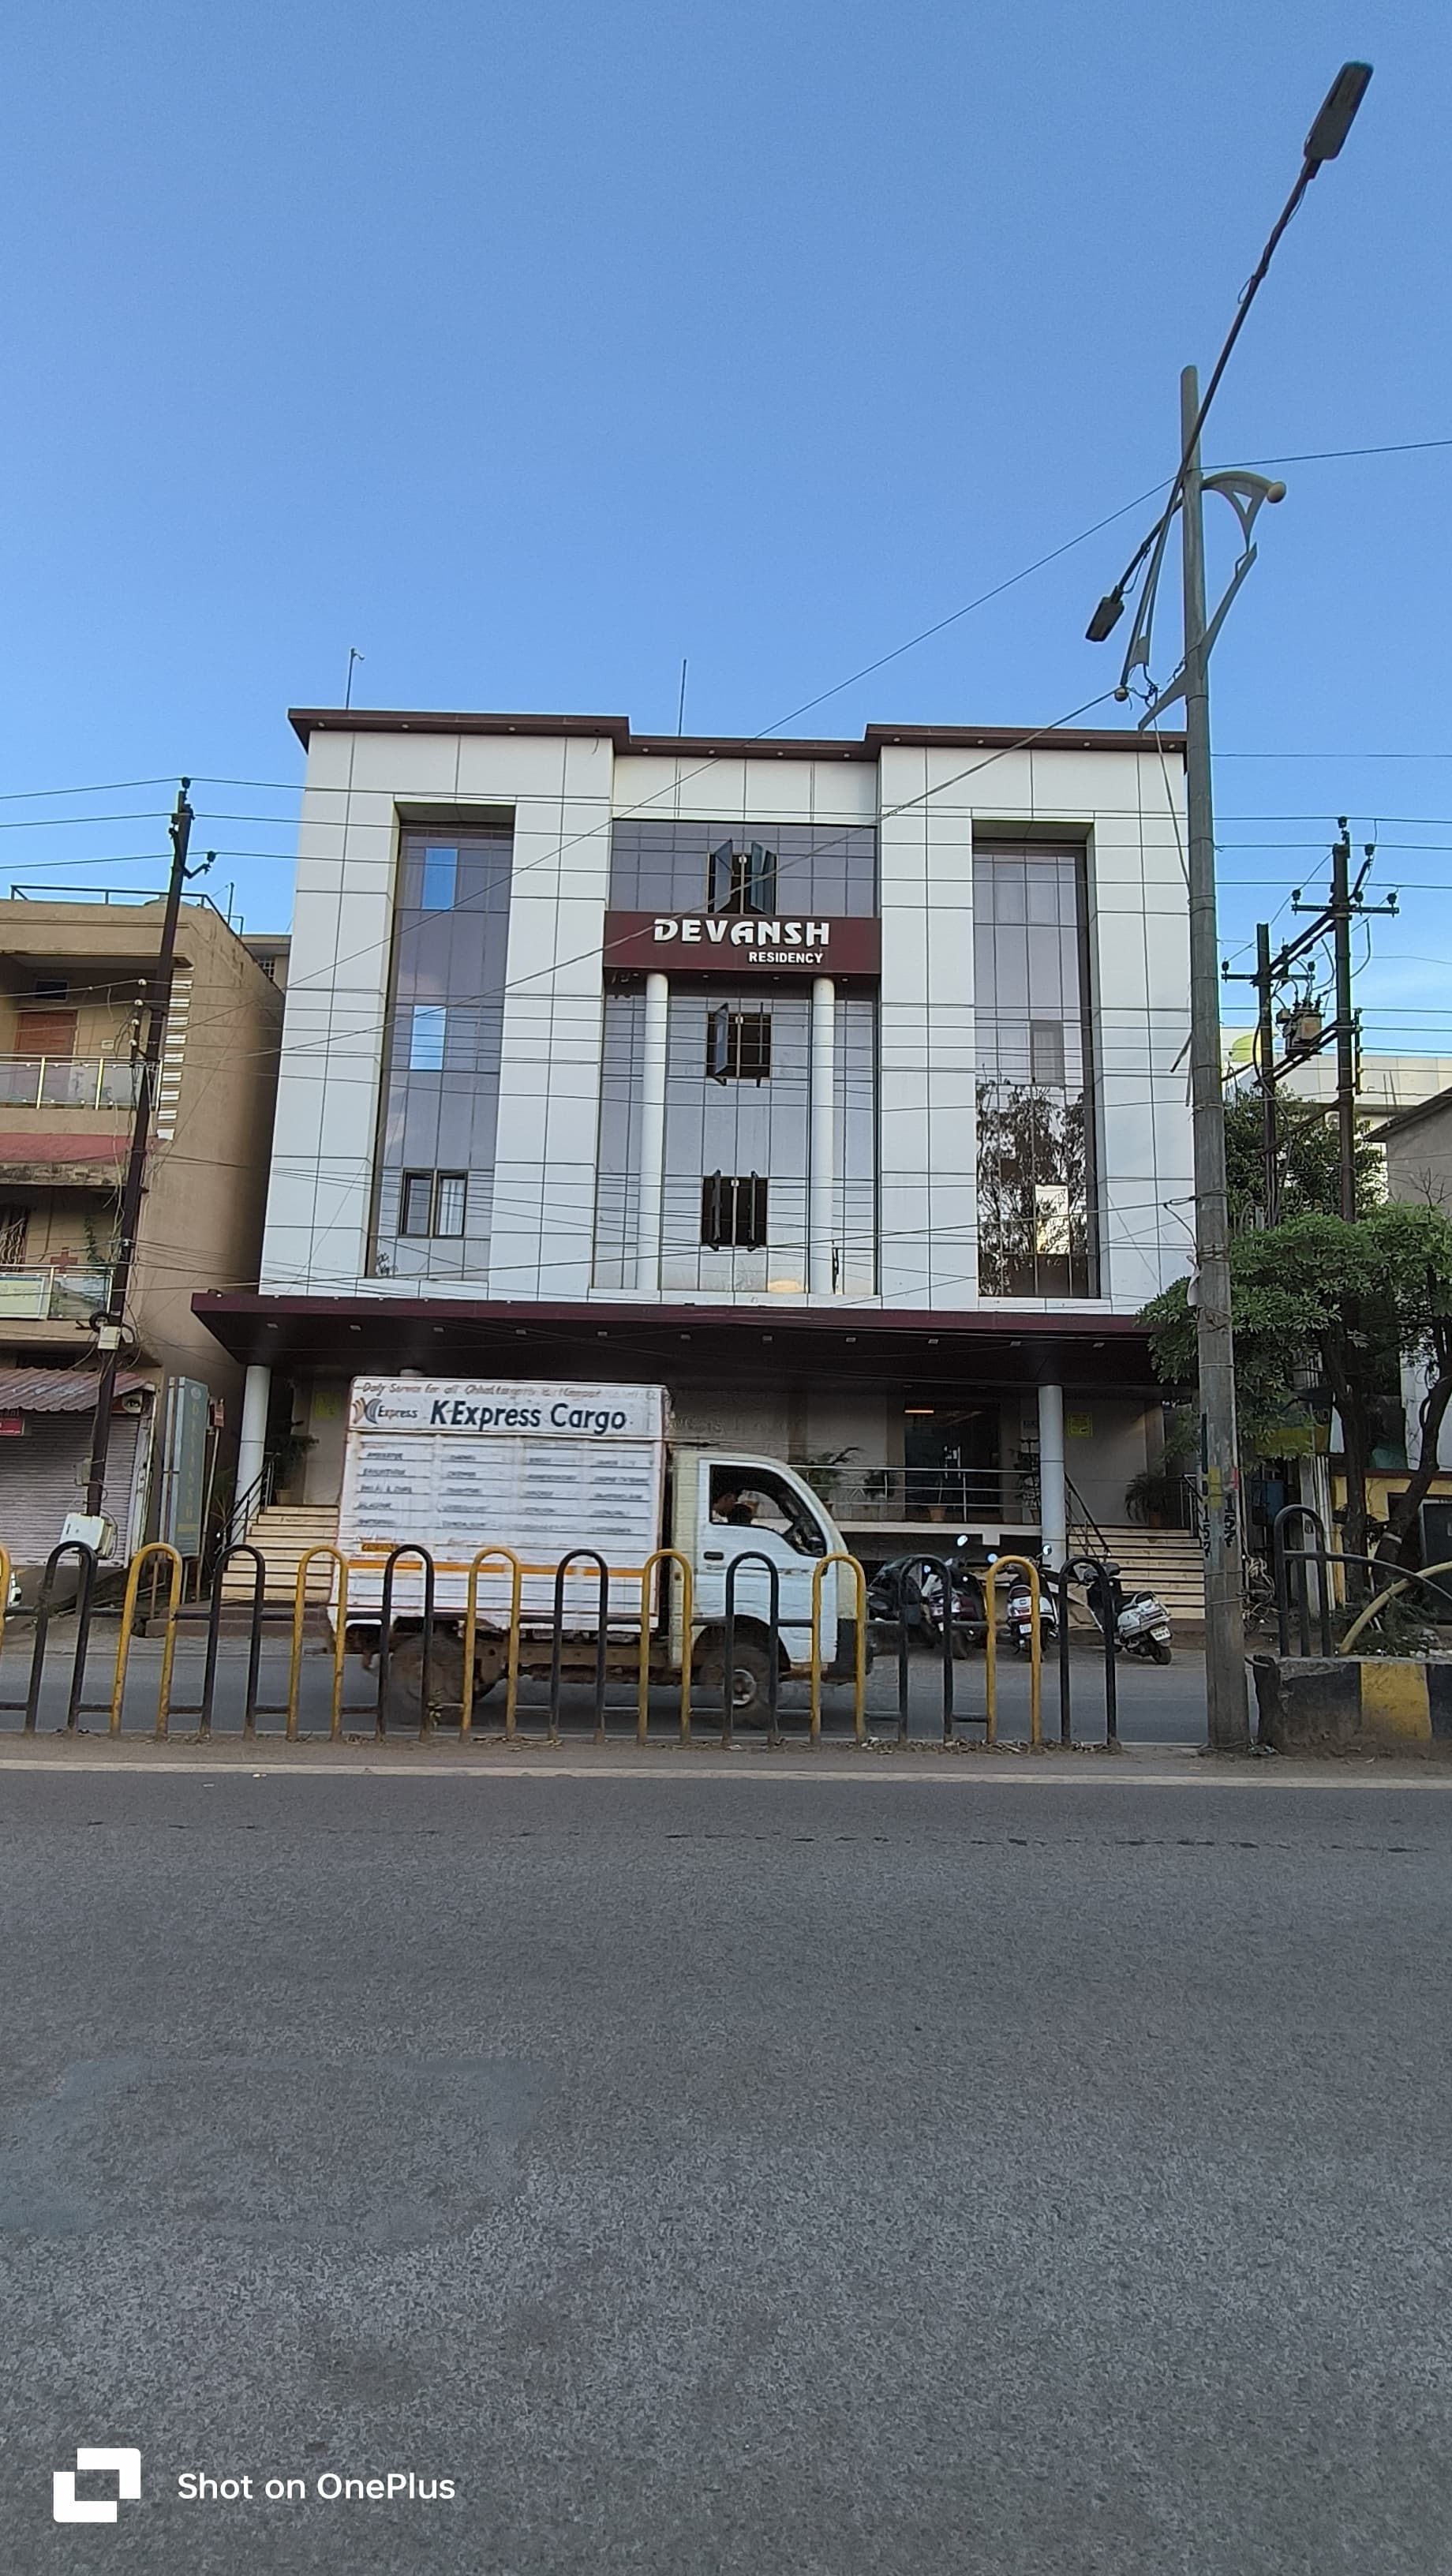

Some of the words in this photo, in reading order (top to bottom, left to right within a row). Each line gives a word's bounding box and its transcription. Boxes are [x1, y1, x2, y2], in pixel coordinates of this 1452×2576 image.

[653, 918, 829, 947] DEVANSH
[748, 952, 824, 964] RESIDENCY
[377, 1405, 419, 1421] Express
[550, 1402, 627, 1435] Cargo
